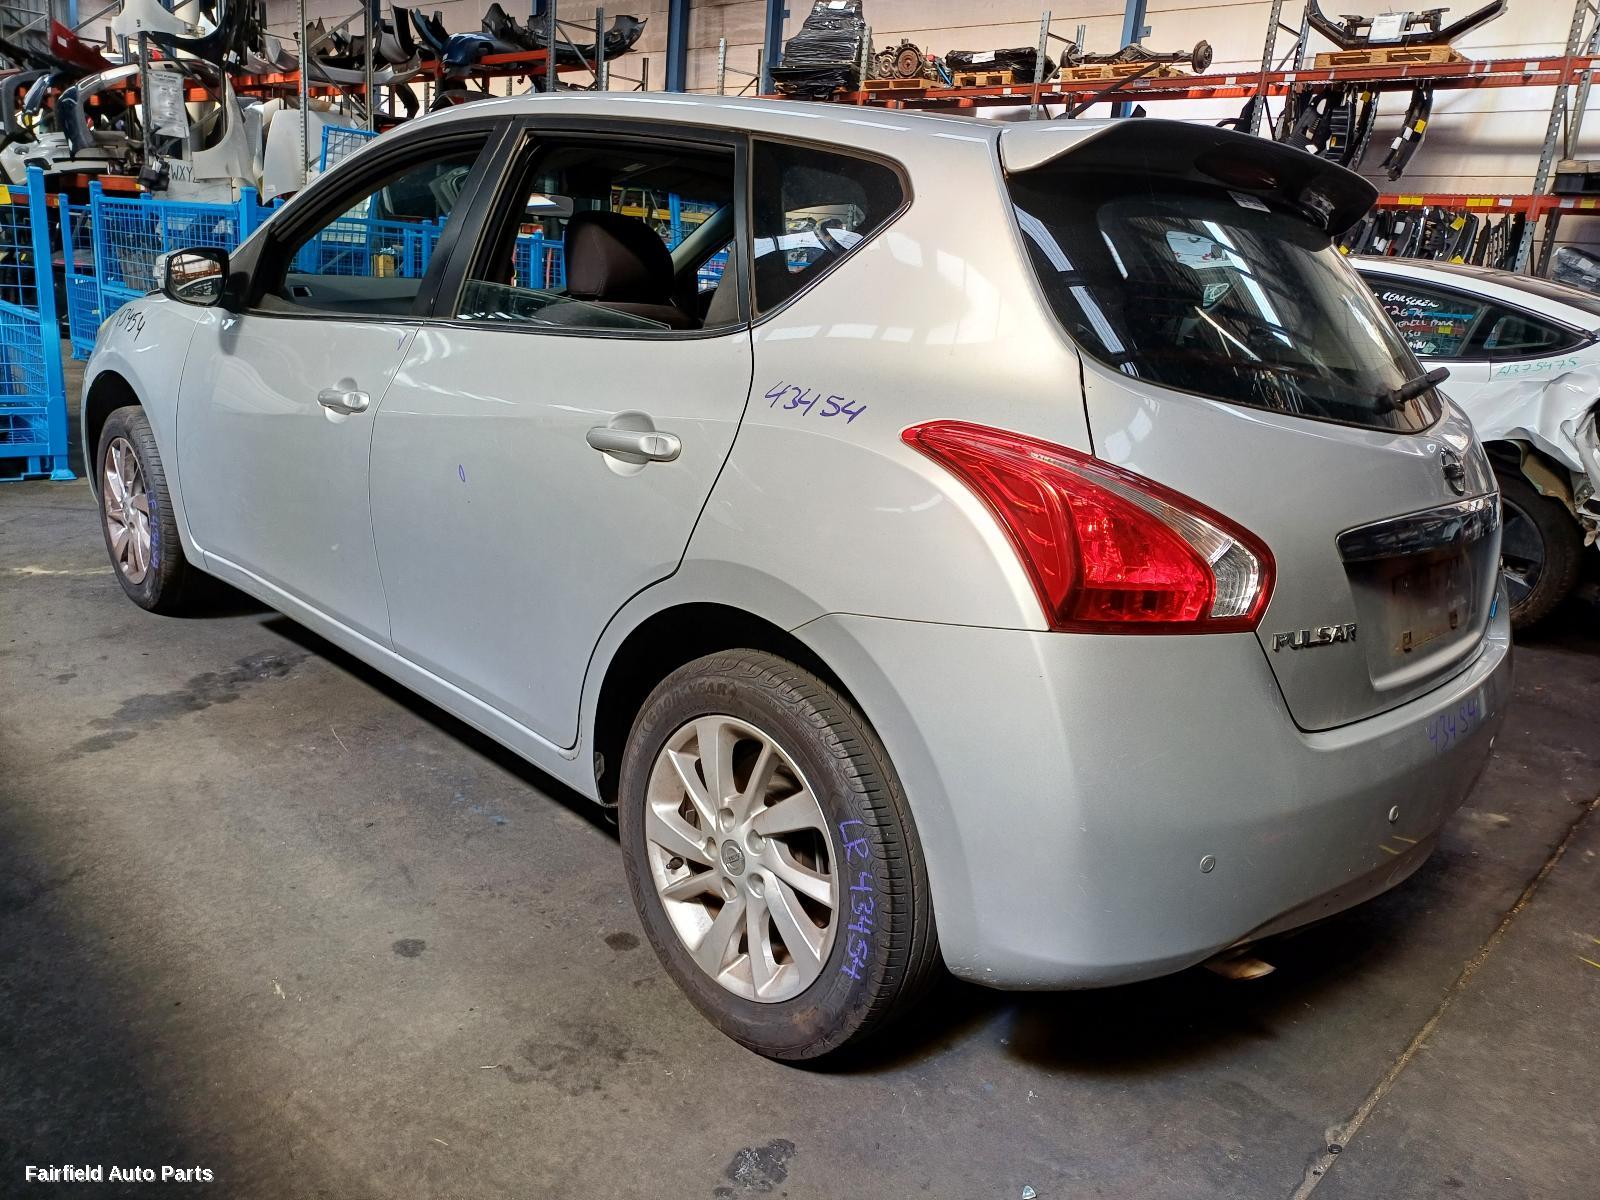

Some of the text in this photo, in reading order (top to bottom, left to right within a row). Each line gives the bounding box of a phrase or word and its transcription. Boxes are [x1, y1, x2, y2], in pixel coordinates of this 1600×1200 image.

[764, 380, 867, 424] 43454
[1271, 622, 1357, 652] PULSAR
[840, 872, 875, 981] 43454
